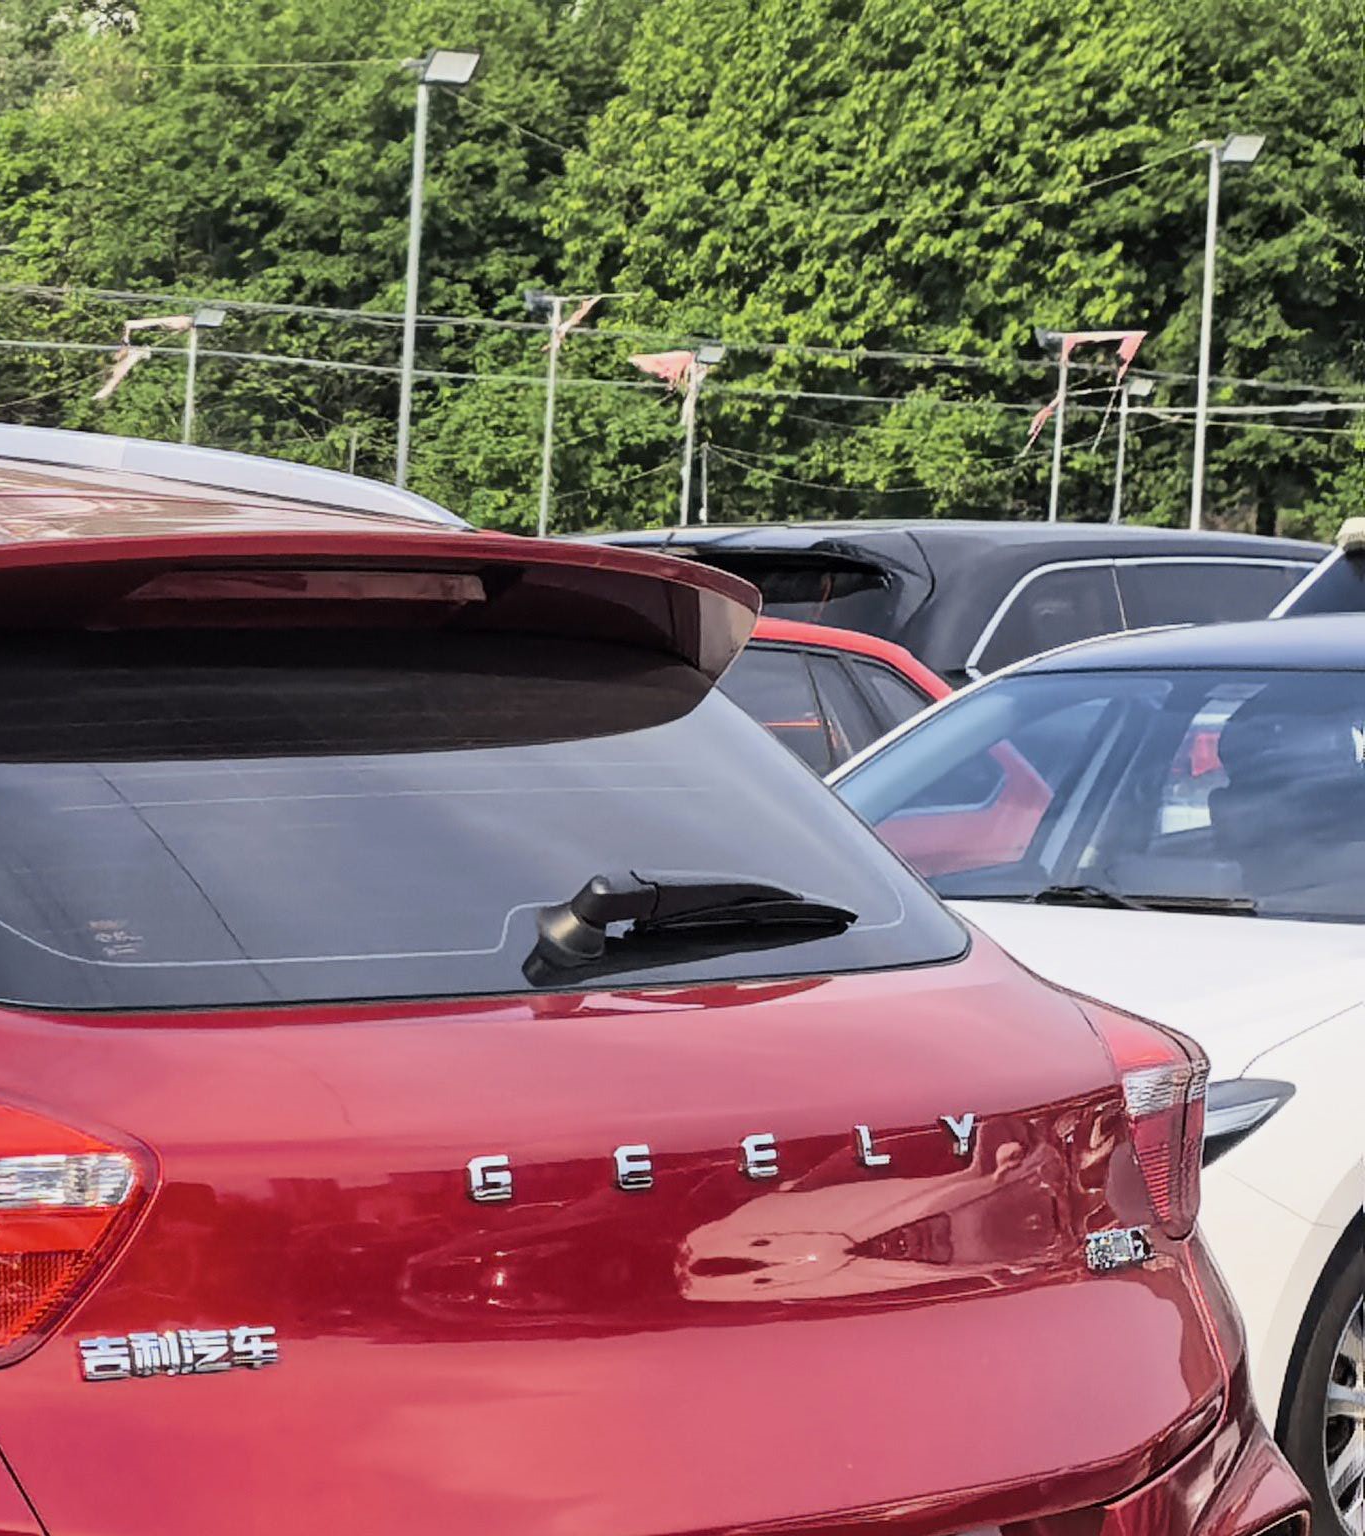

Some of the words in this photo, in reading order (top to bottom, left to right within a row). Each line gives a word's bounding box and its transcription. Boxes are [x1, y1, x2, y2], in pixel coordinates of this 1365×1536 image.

[468, 1112, 977, 1201] GEELY
[79, 1326, 278, 1380] 吉利汽车
